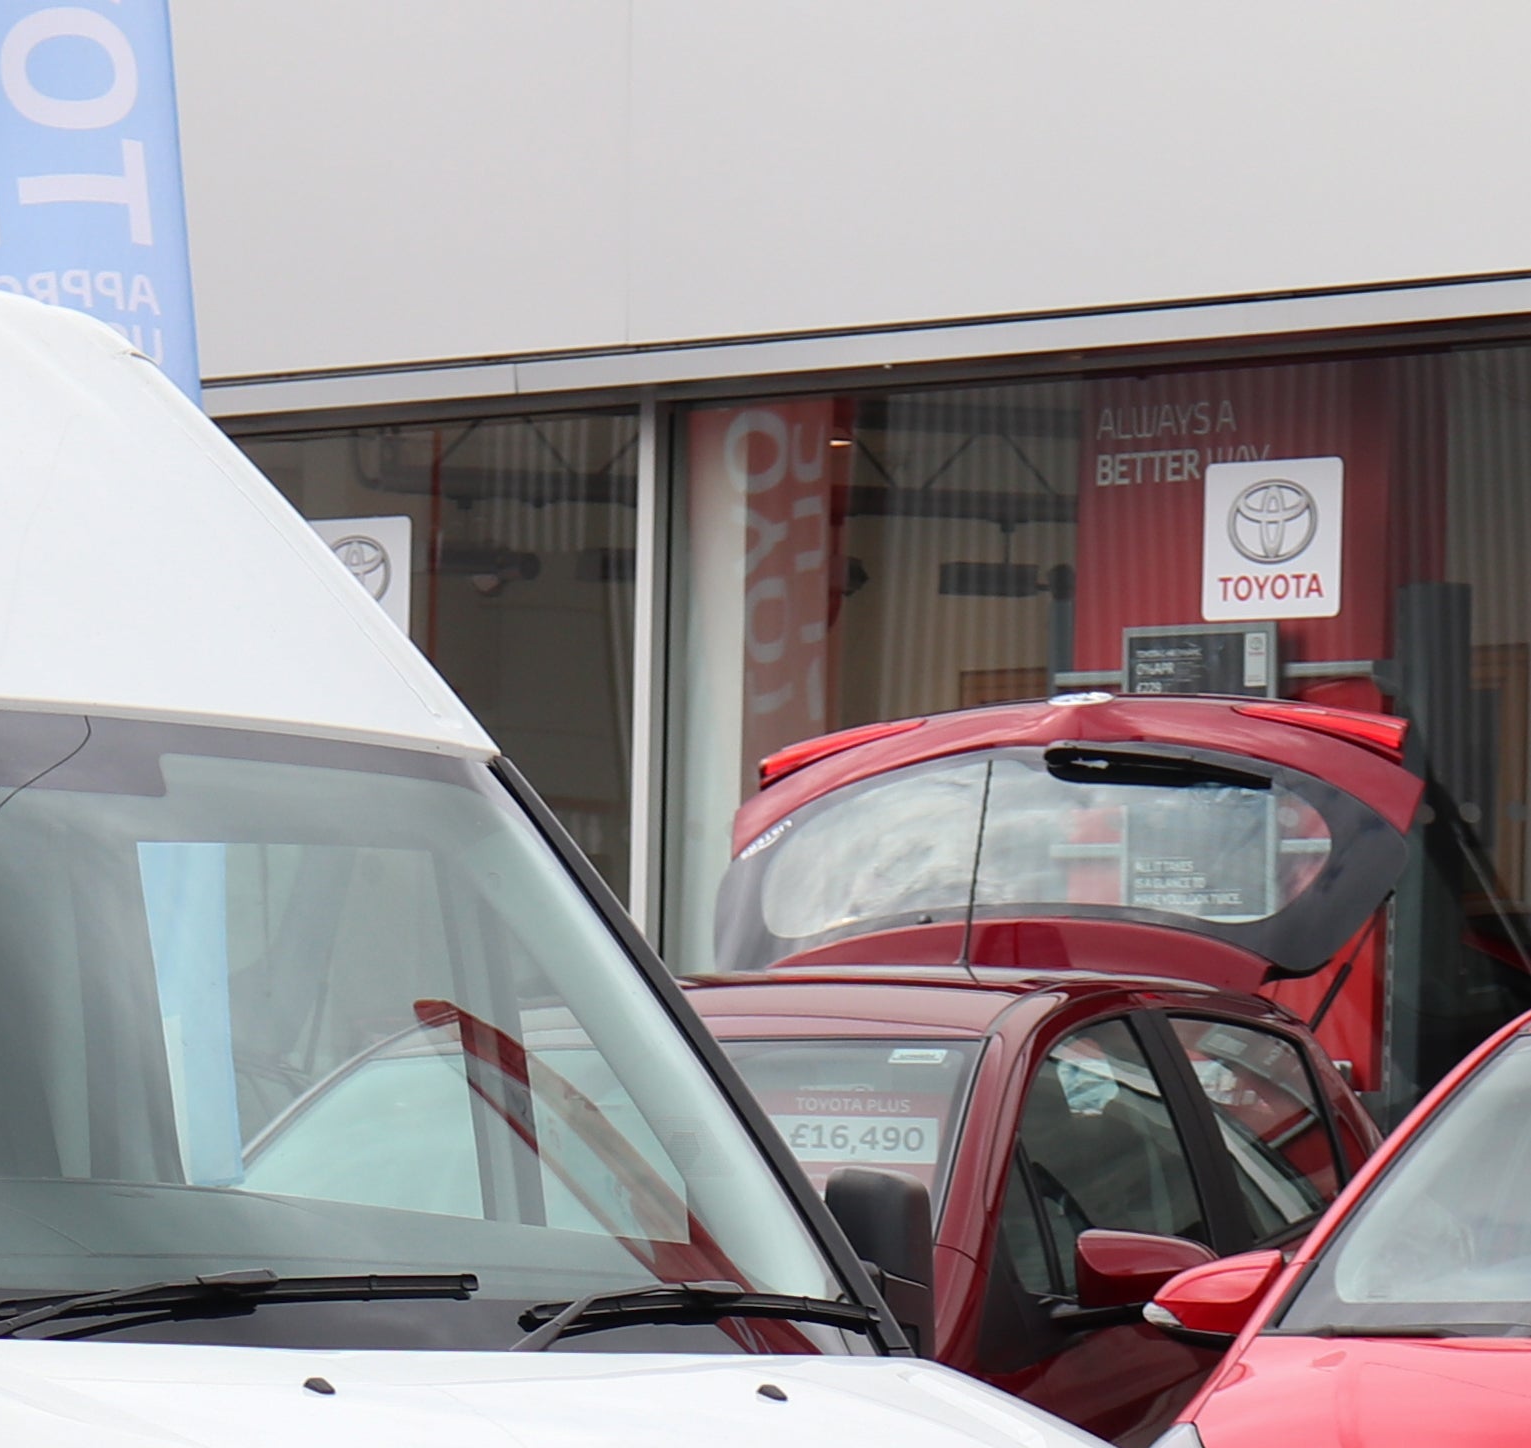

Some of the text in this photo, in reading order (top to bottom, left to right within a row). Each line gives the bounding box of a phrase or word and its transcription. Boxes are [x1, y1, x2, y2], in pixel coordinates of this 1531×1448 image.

[1096, 399, 1237, 440] ALWAYS A
[1096, 448, 1201, 487] BETTER
[1217, 572, 1324, 602] TOYOTA
[795, 1096, 911, 1113] TOYOTA PLUS
[789, 1122, 925, 1155] £16,490
